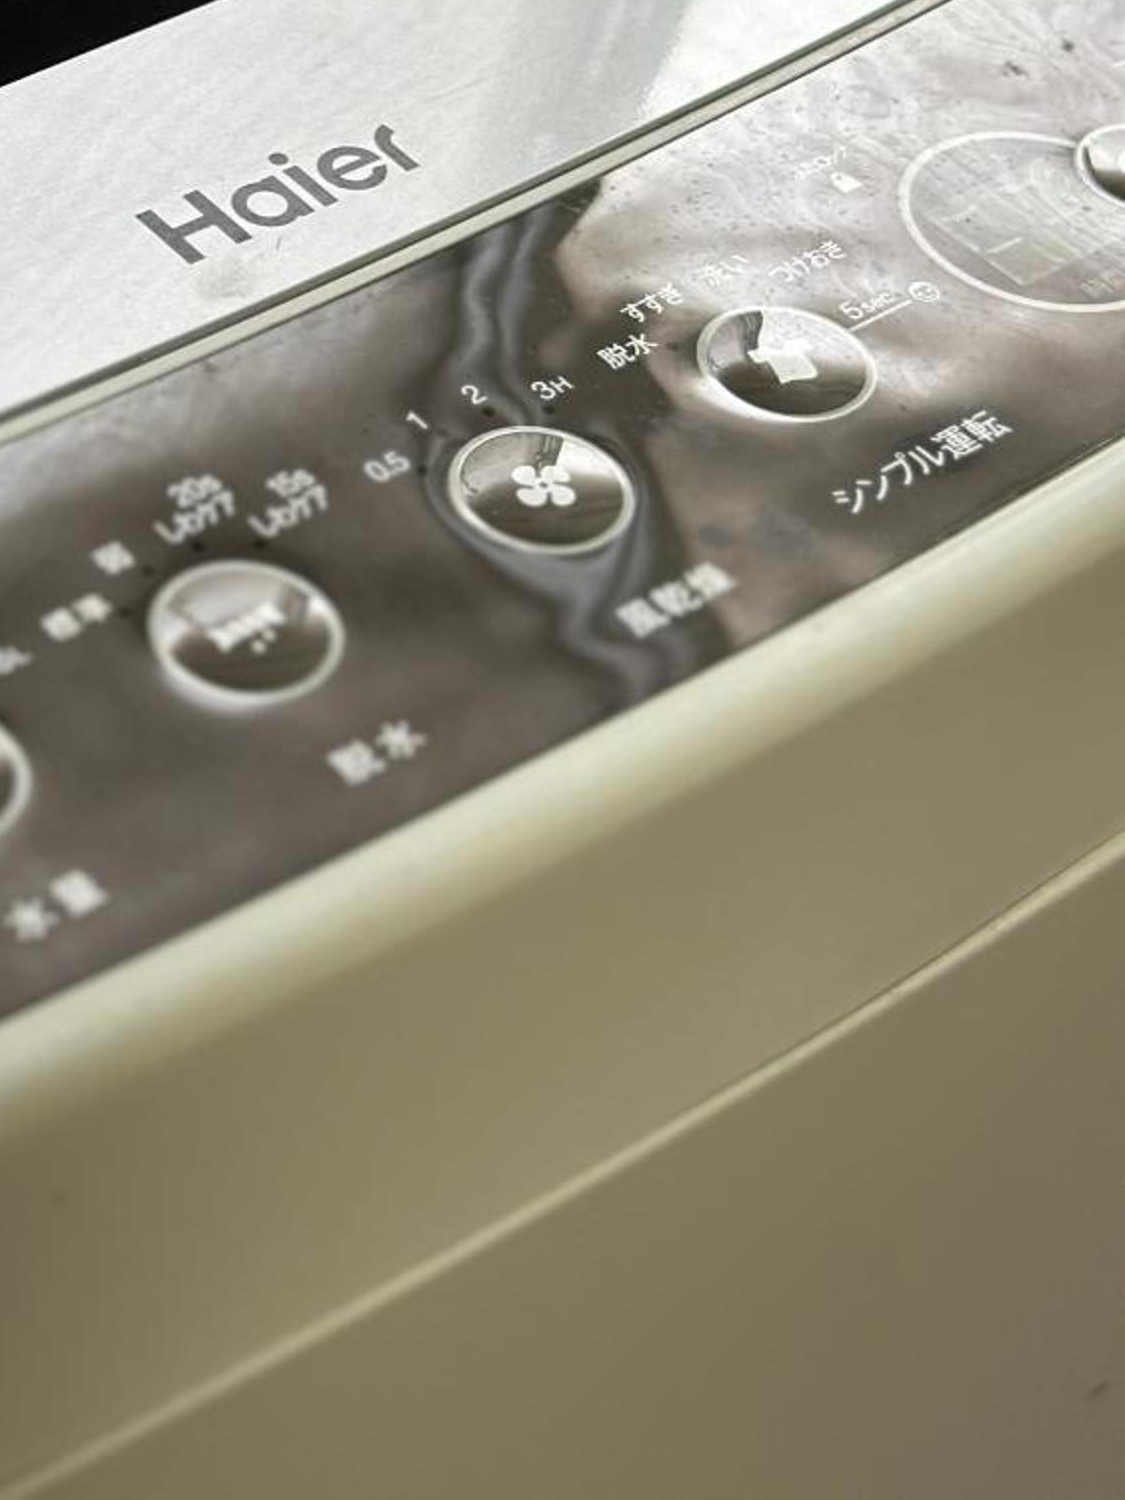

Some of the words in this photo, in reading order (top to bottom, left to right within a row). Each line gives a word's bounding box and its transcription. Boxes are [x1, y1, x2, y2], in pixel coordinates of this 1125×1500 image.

[135, 124, 420, 264] Haier
[768, 240, 846, 283] つけおき
[619, 281, 684, 322] すすぎ
[597, 332, 658, 370] 脱水
[461, 384, 489, 406] 2
[530, 374, 575, 401] 3H
[406, 410, 429, 431] 1
[363, 450, 411, 483] 0.5
[831, 409, 1013, 514] シンプル運転
